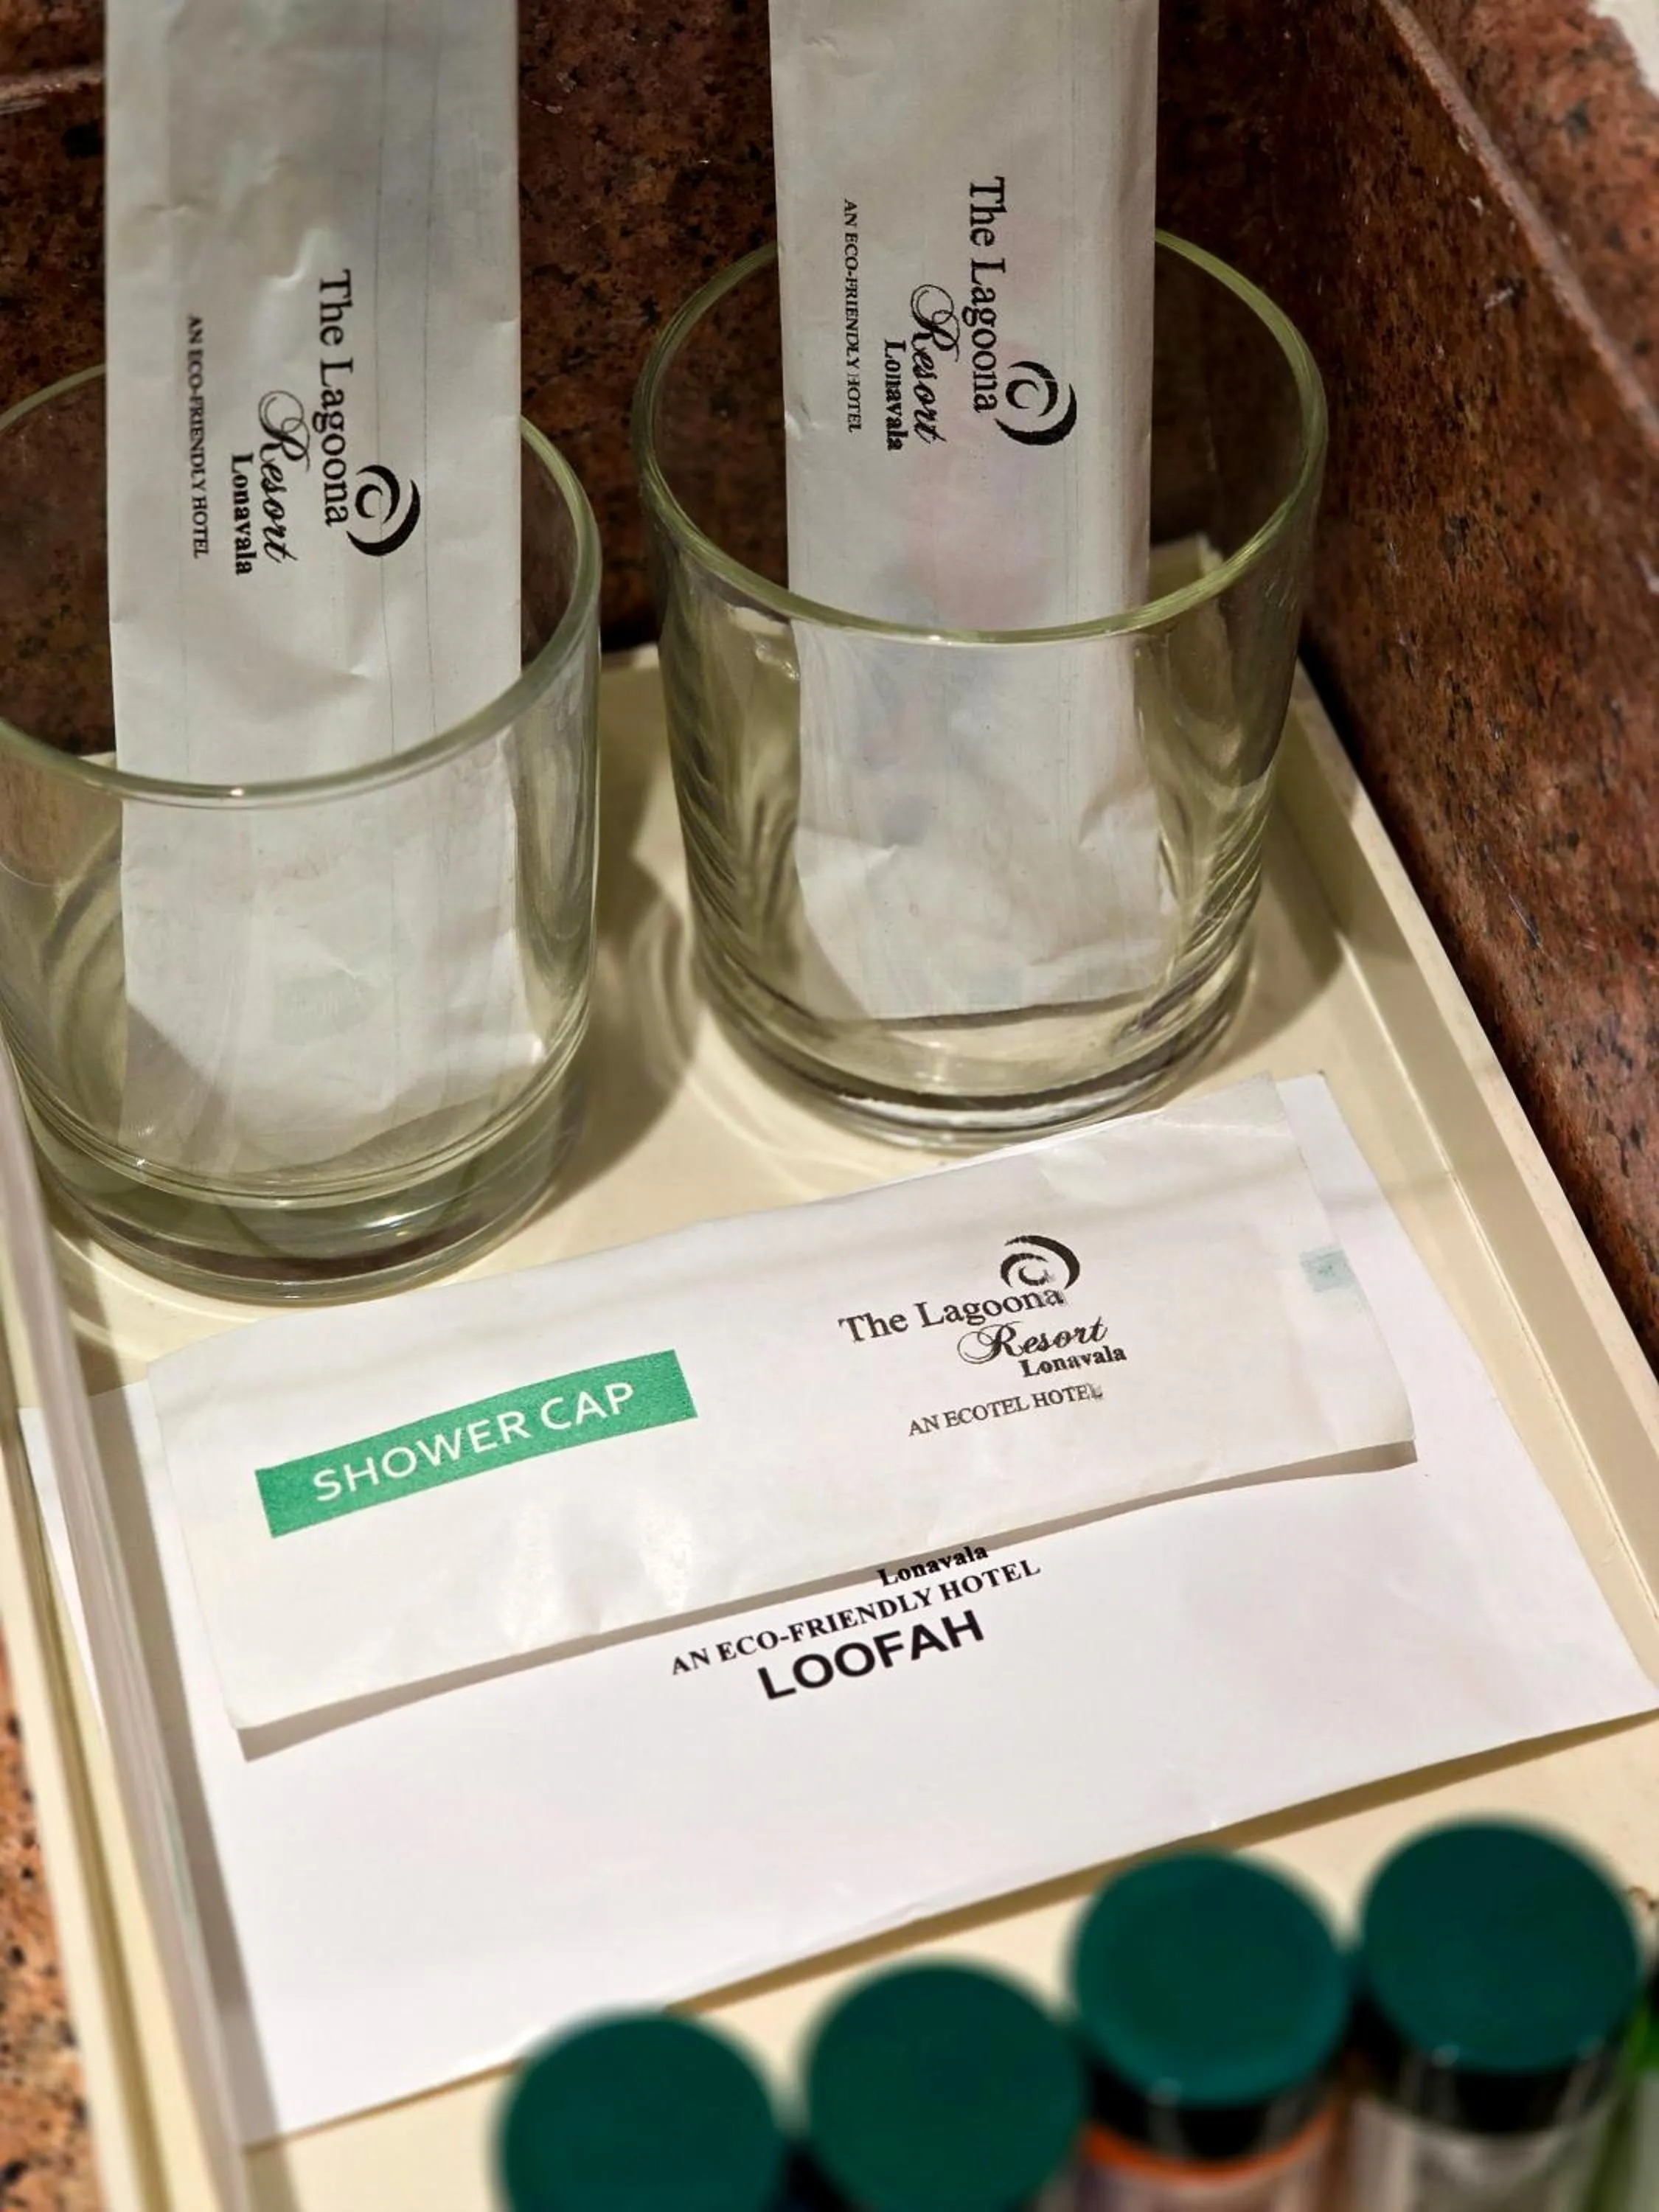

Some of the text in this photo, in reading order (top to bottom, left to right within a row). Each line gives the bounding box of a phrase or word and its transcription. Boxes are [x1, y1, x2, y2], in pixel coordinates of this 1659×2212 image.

[844, 199, 862, 433] AN ECO-FRIENDLY HOTEL
[961, 175, 1007, 413] The Lagoona
[312, 269, 354, 527] The Lagoona
[885, 338, 908, 451] Lonavala
[911, 284, 960, 445] Resort
[187, 316, 209, 558] AN ECO-FRIENDLY HOTEL
[258, 390, 310, 564] Resort
[232, 451, 257, 575] Lonavala
[838, 1288, 1065, 1343] The Lagoona
[957, 1316, 1107, 1364] Resort
[1019, 1345, 1127, 1377] Lonavala
[313, 1382, 633, 1502] SHOWER CAP
[908, 1382, 1104, 1437] AN ECOTEL HOTEL
[672, 1559, 1040, 1675] AN ECO-FRIENDLY HOTEL
[877, 1546, 989, 1587] Lonavala
[758, 1610, 984, 1700] LOOFAH
